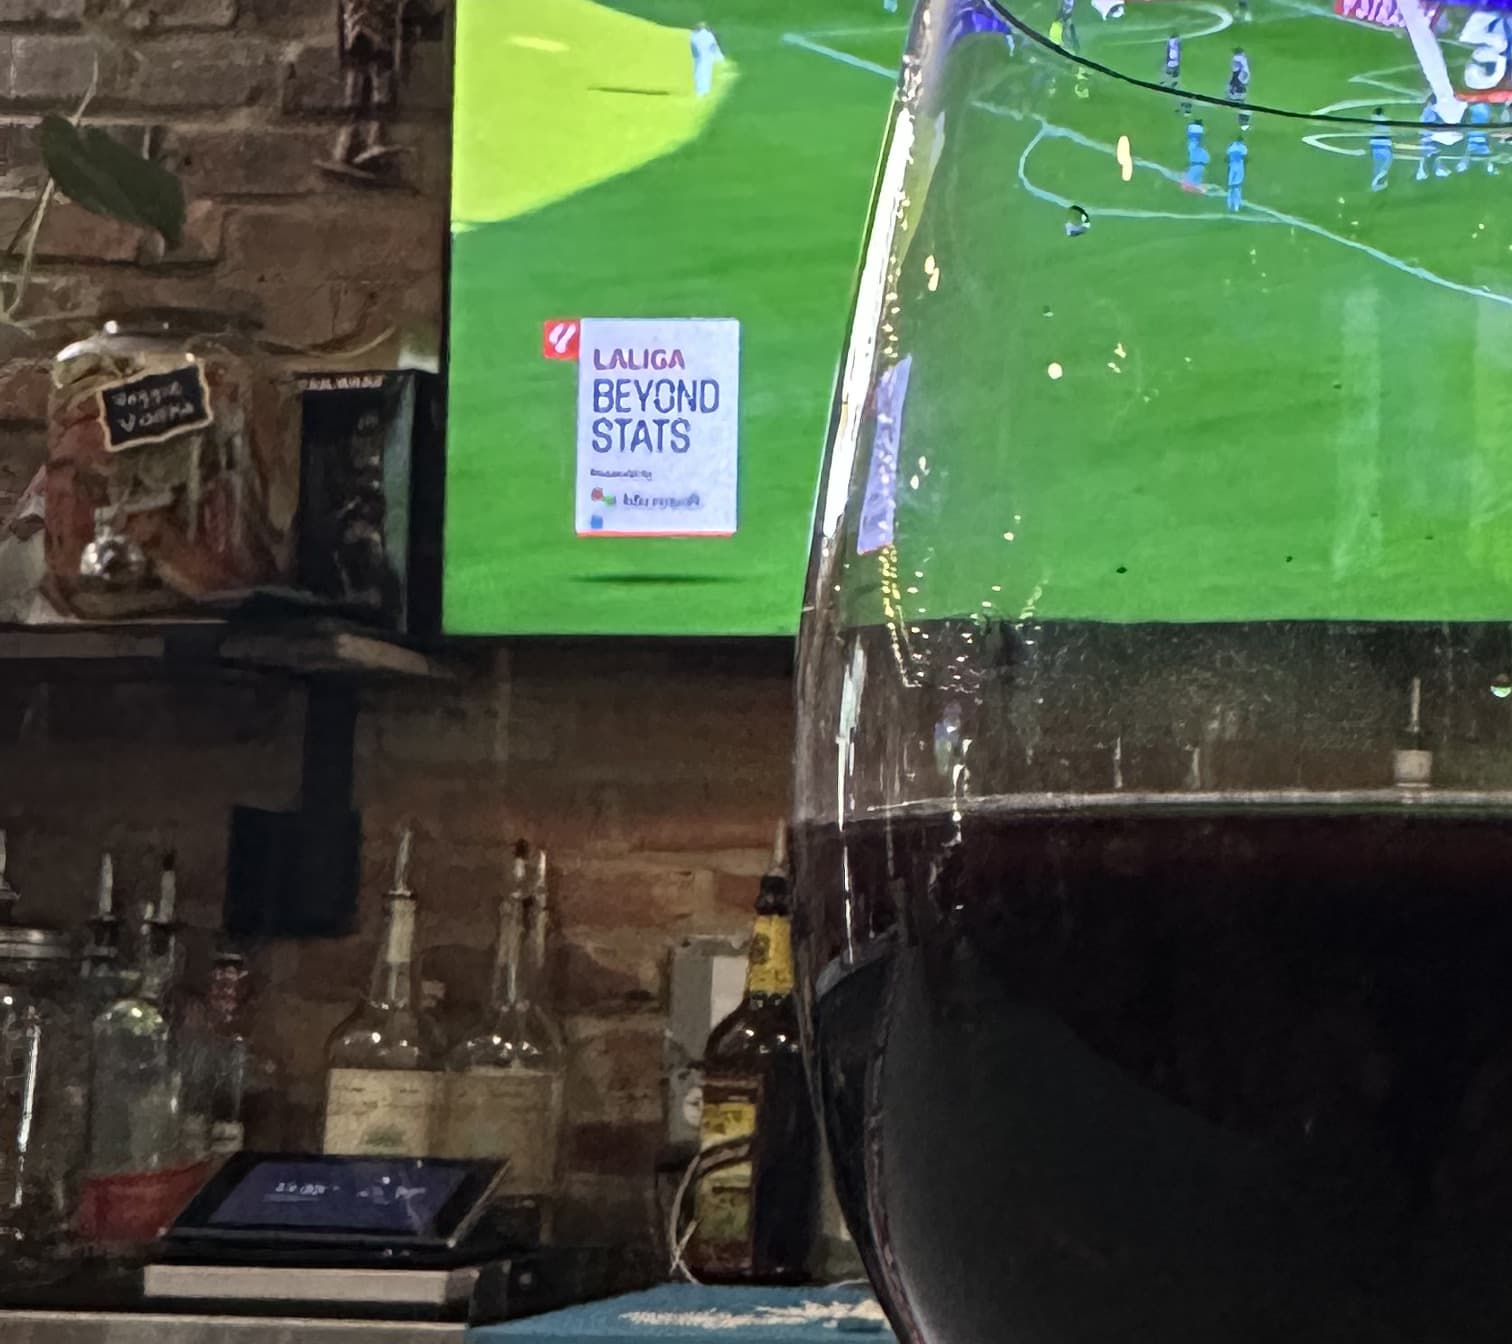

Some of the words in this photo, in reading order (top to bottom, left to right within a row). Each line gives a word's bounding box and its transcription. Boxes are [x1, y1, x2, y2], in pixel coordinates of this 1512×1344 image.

[592, 348, 686, 371] LALIGA
[592, 378, 720, 414] BEYOND
[591, 417, 692, 454] STATS
